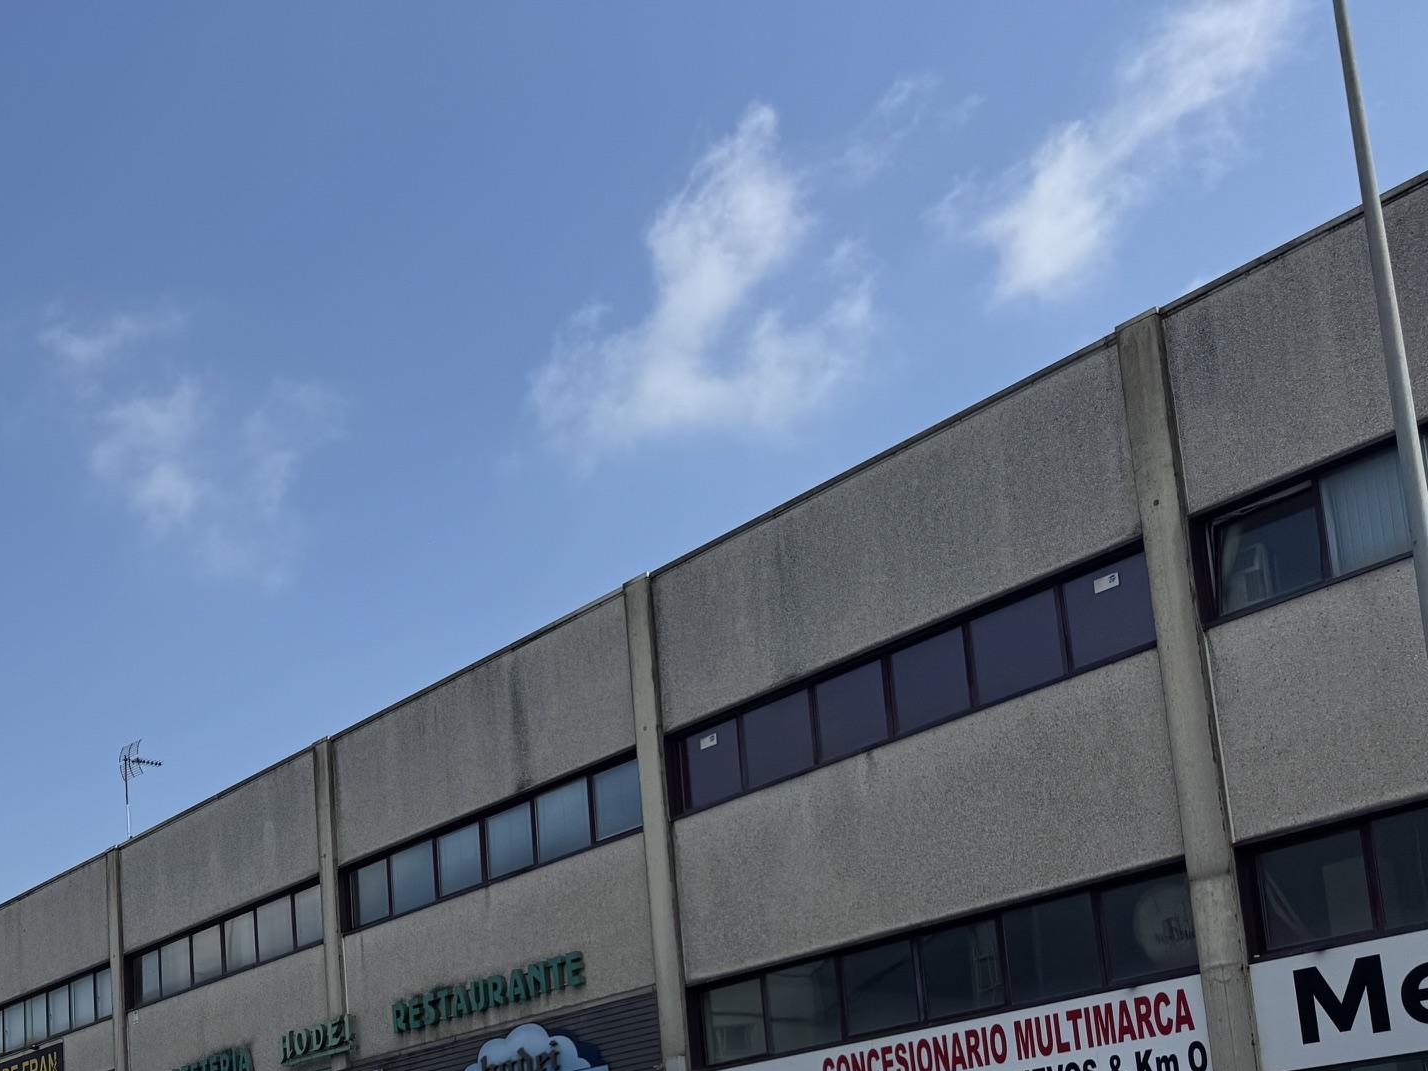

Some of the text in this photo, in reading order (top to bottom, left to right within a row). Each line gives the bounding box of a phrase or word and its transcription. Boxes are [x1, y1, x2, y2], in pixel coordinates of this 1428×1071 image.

[392, 951, 586, 1034] RESTAURANTE
[1013, 989, 1196, 1061] MULTIMARCA
[281, 1014, 356, 1065] HODEI
